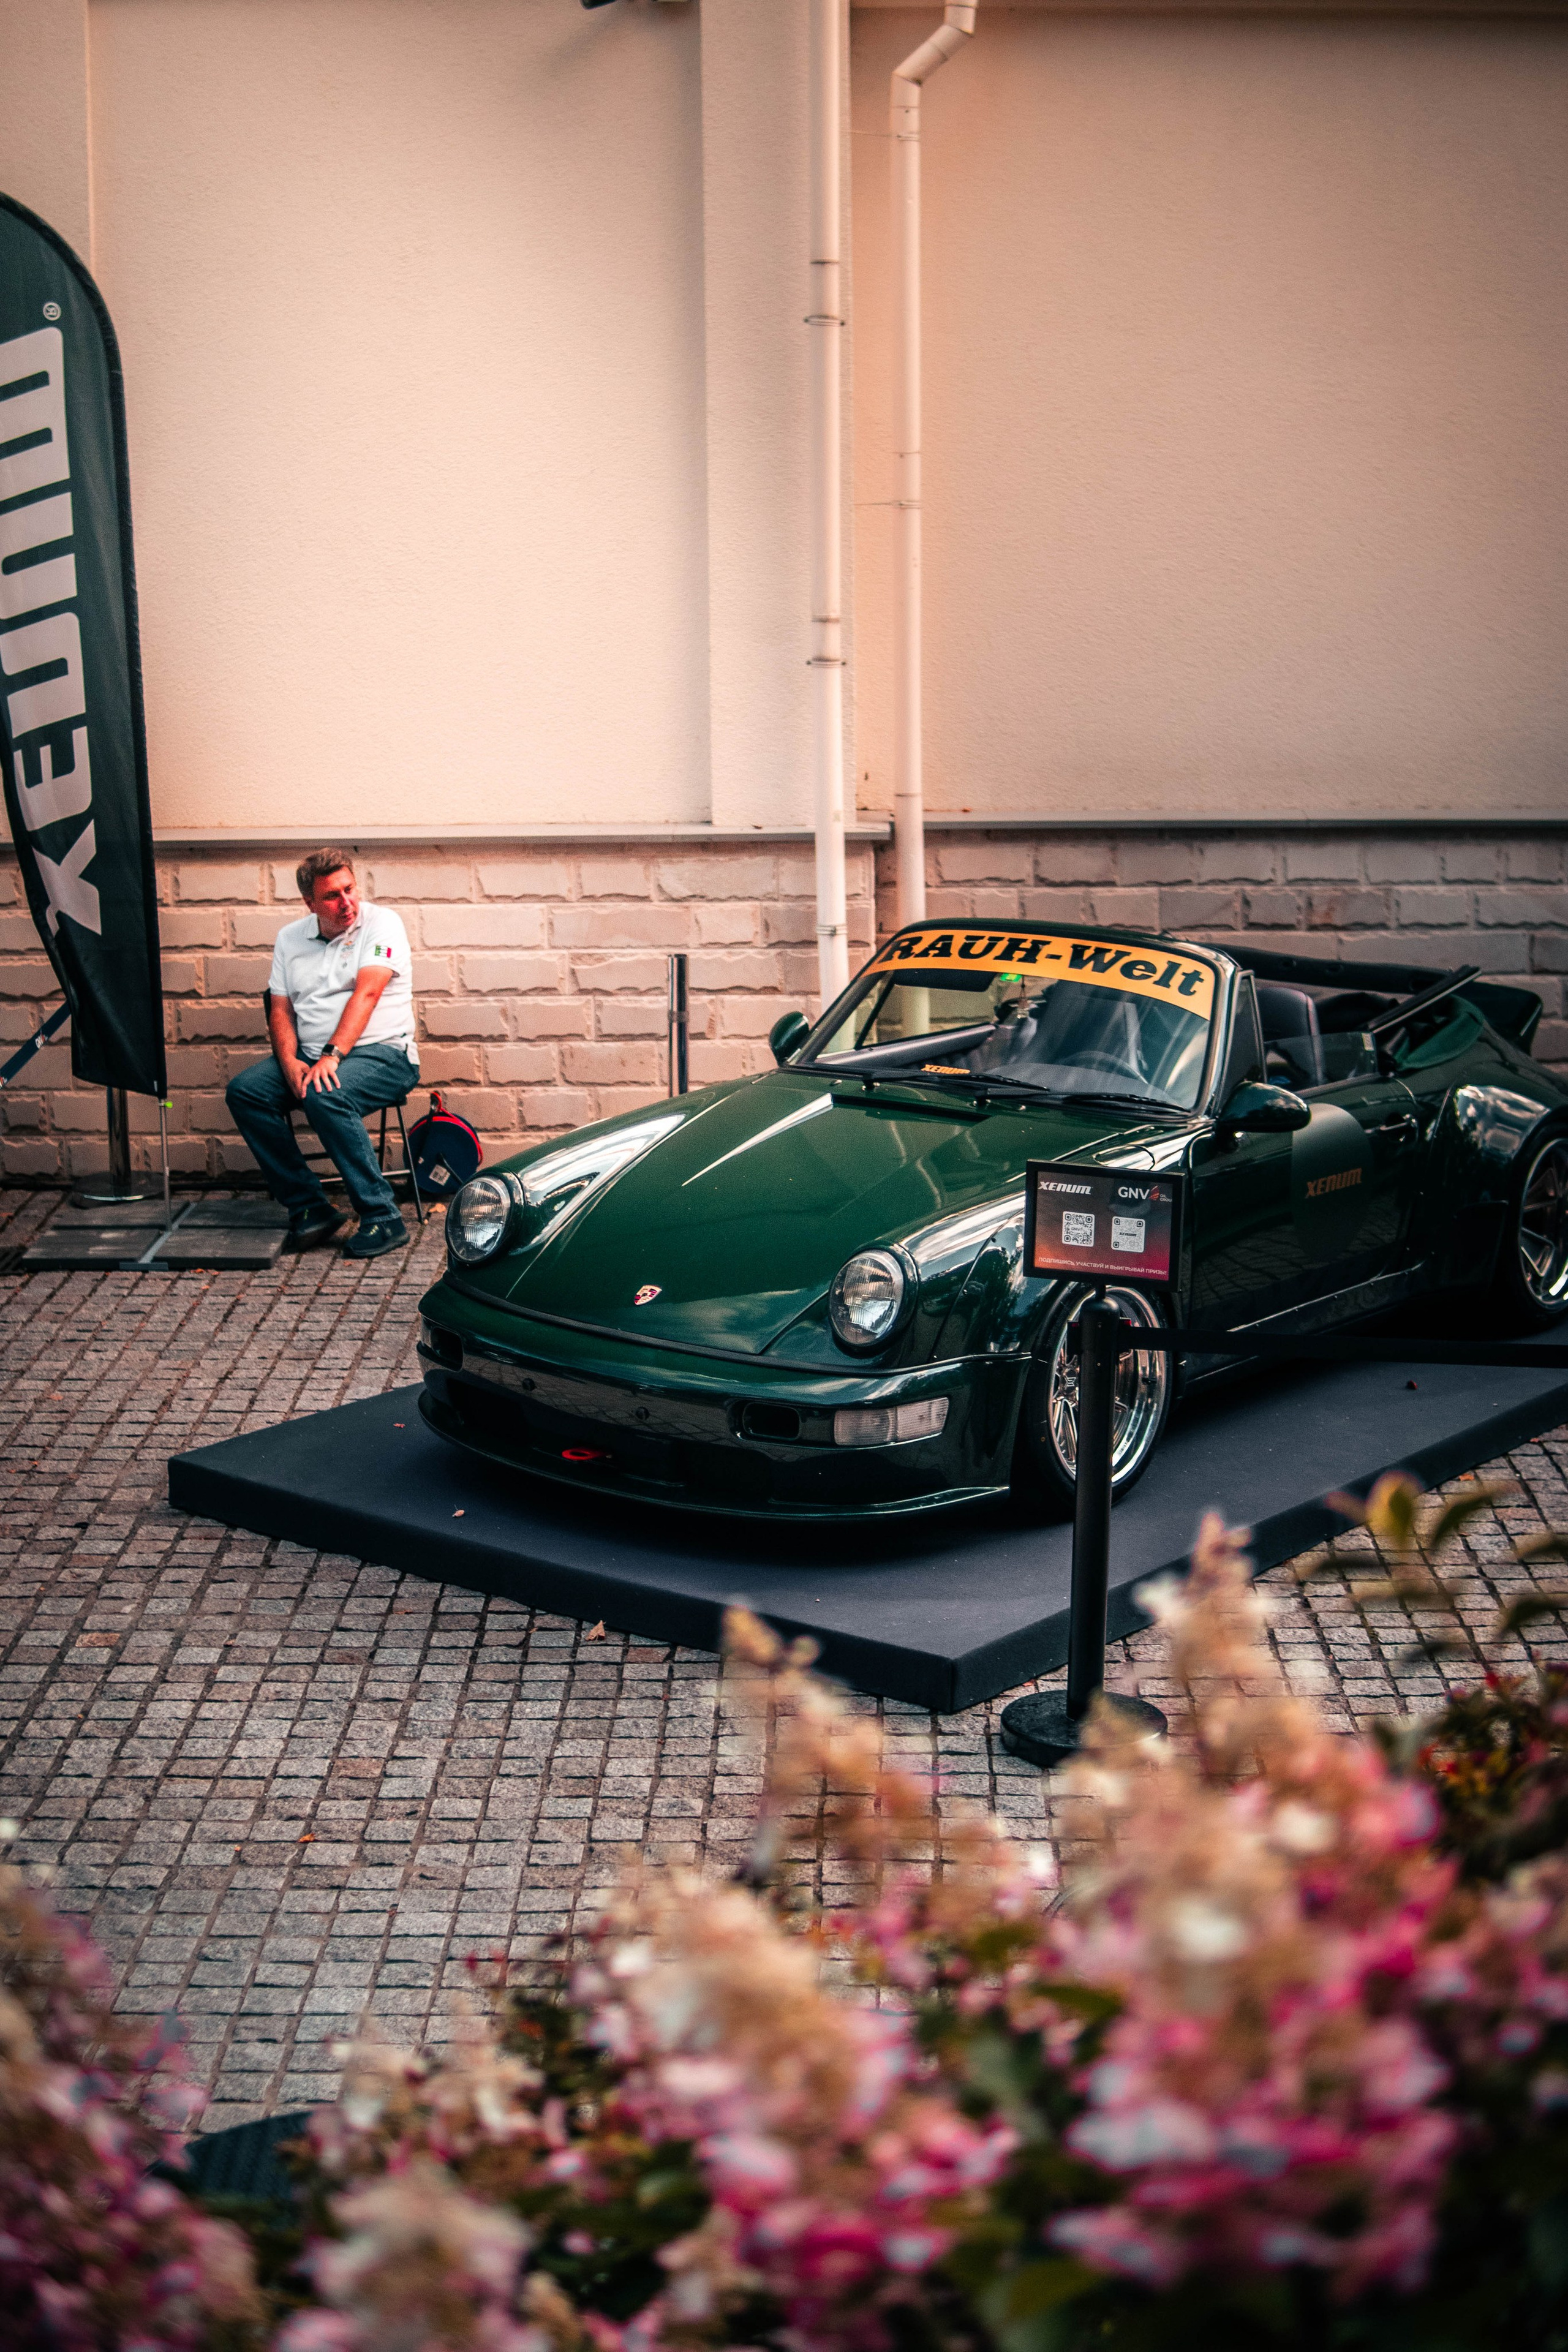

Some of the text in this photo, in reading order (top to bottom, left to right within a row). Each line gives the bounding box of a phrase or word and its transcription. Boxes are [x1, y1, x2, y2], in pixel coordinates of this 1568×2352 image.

[878, 934, 1205, 997] RAUH-Welt
[1118, 1186, 1150, 1200] GNV
[1110, 1264, 1144, 1273] ВЫИГРЫВАЙ
